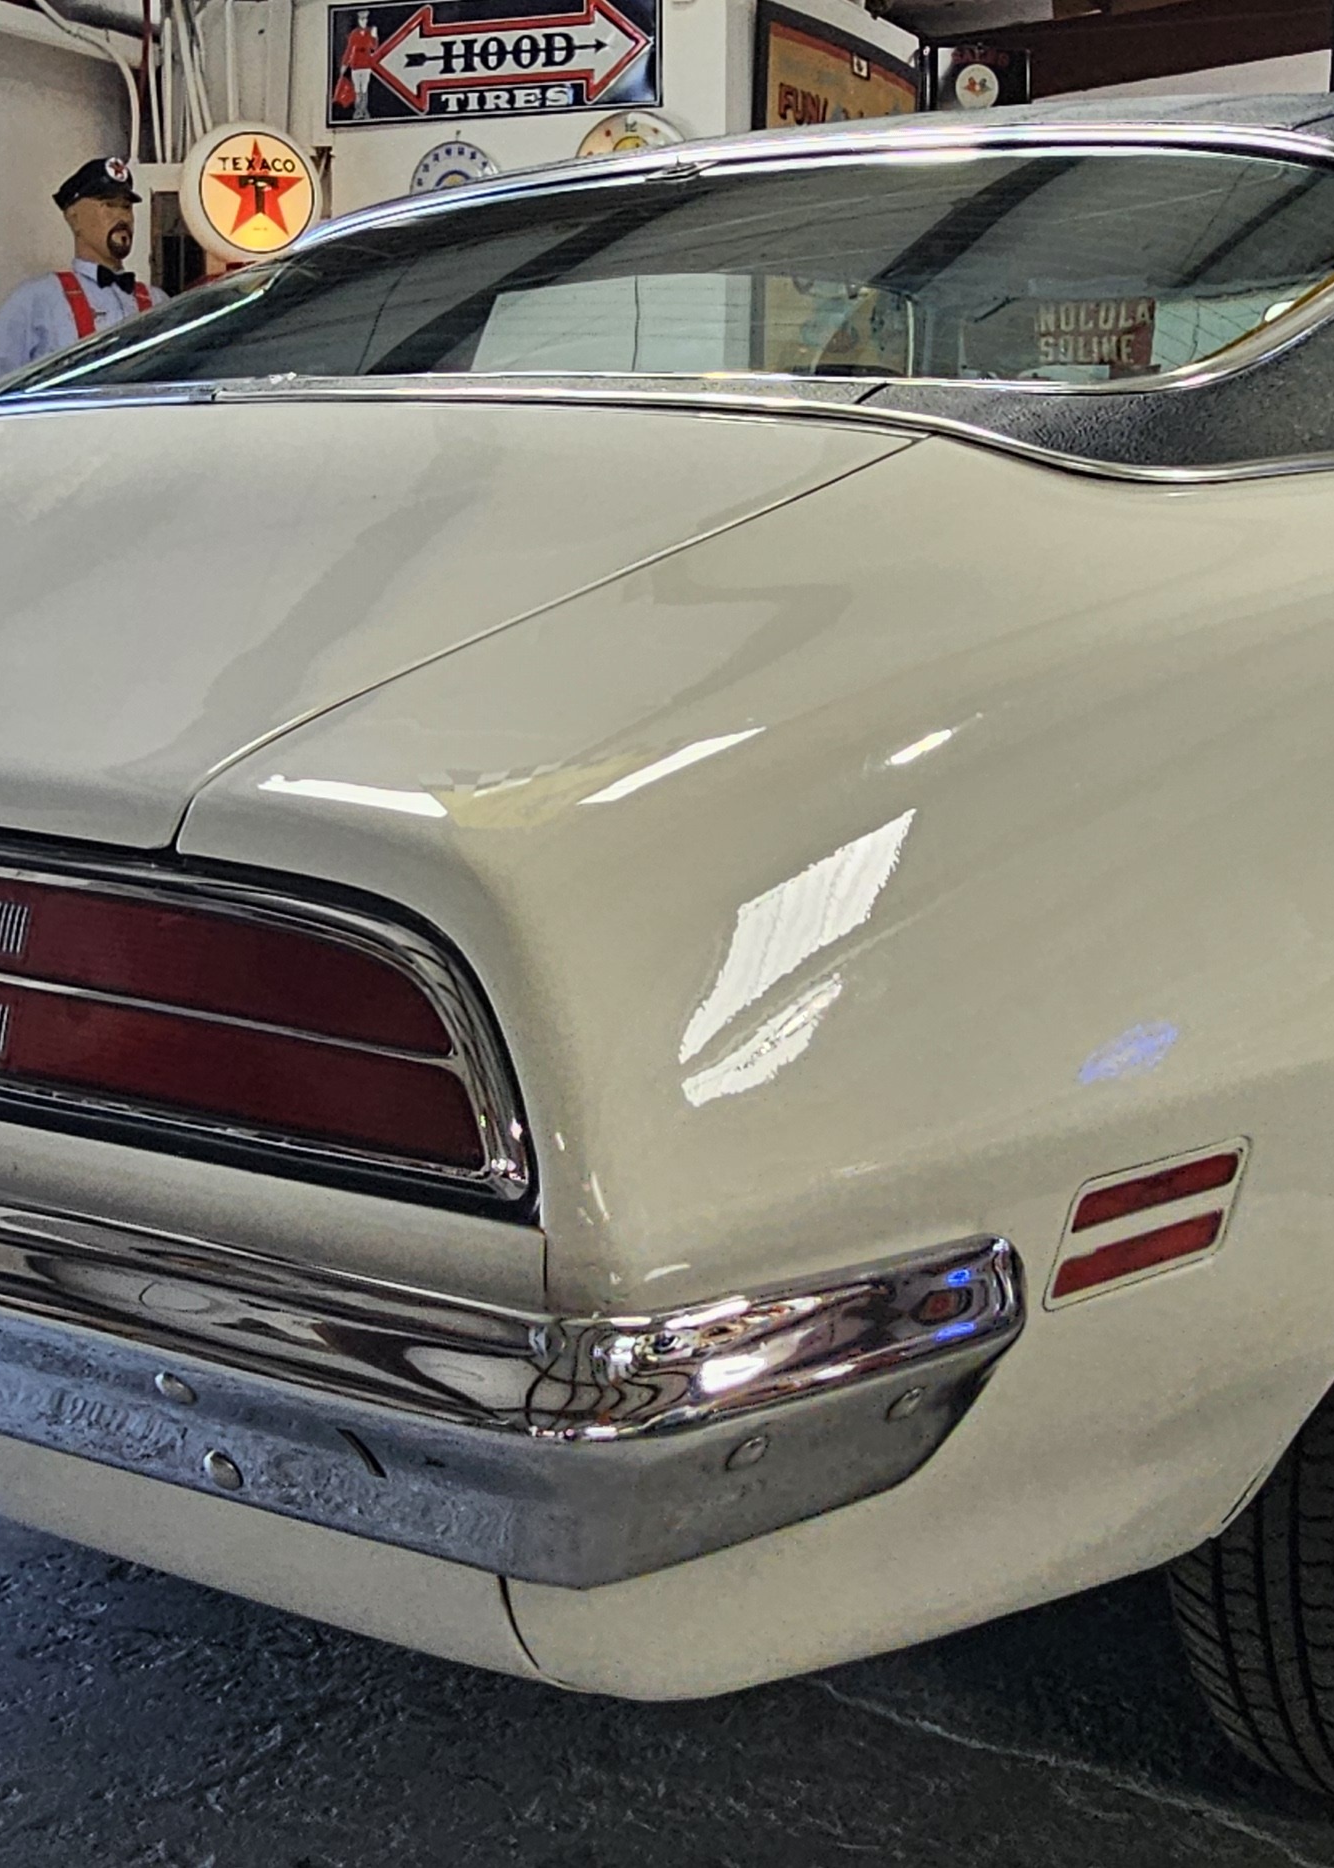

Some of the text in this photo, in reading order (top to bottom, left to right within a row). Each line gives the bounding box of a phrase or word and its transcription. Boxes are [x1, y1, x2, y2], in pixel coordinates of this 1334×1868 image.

[439, 32, 575, 75] HOOD
[441, 84, 574, 112] TIRES
[217, 156, 296, 173] TEXACO
